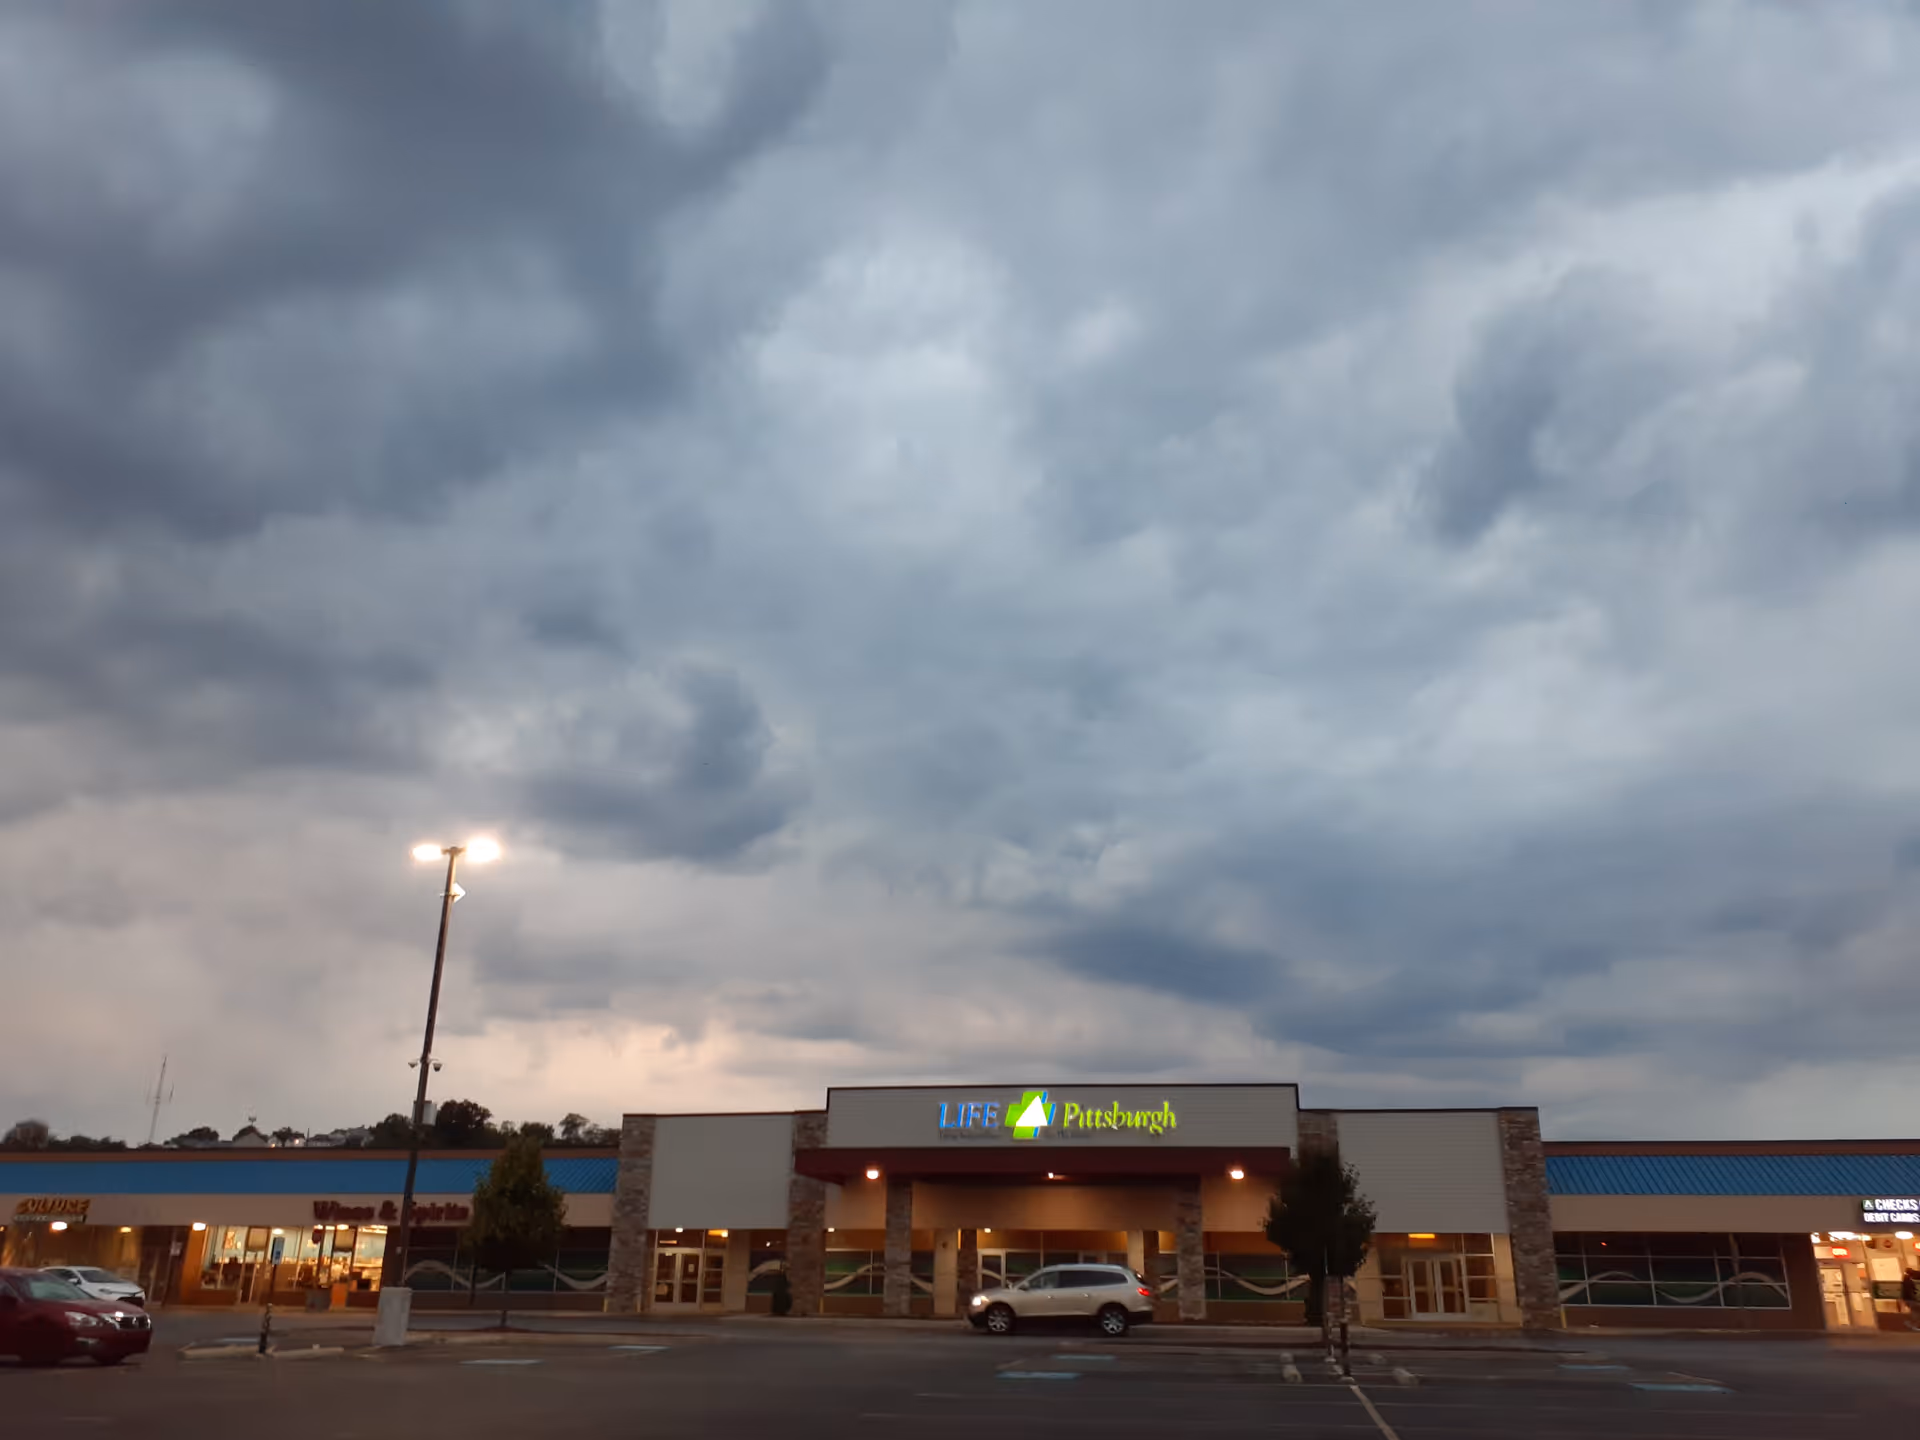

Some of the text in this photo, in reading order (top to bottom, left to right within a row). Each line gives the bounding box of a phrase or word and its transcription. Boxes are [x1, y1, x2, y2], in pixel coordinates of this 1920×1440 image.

[939, 1100, 1177, 1134] LIFE Pittsburgh
[1875, 1199, 1918, 1210] CHECKS
